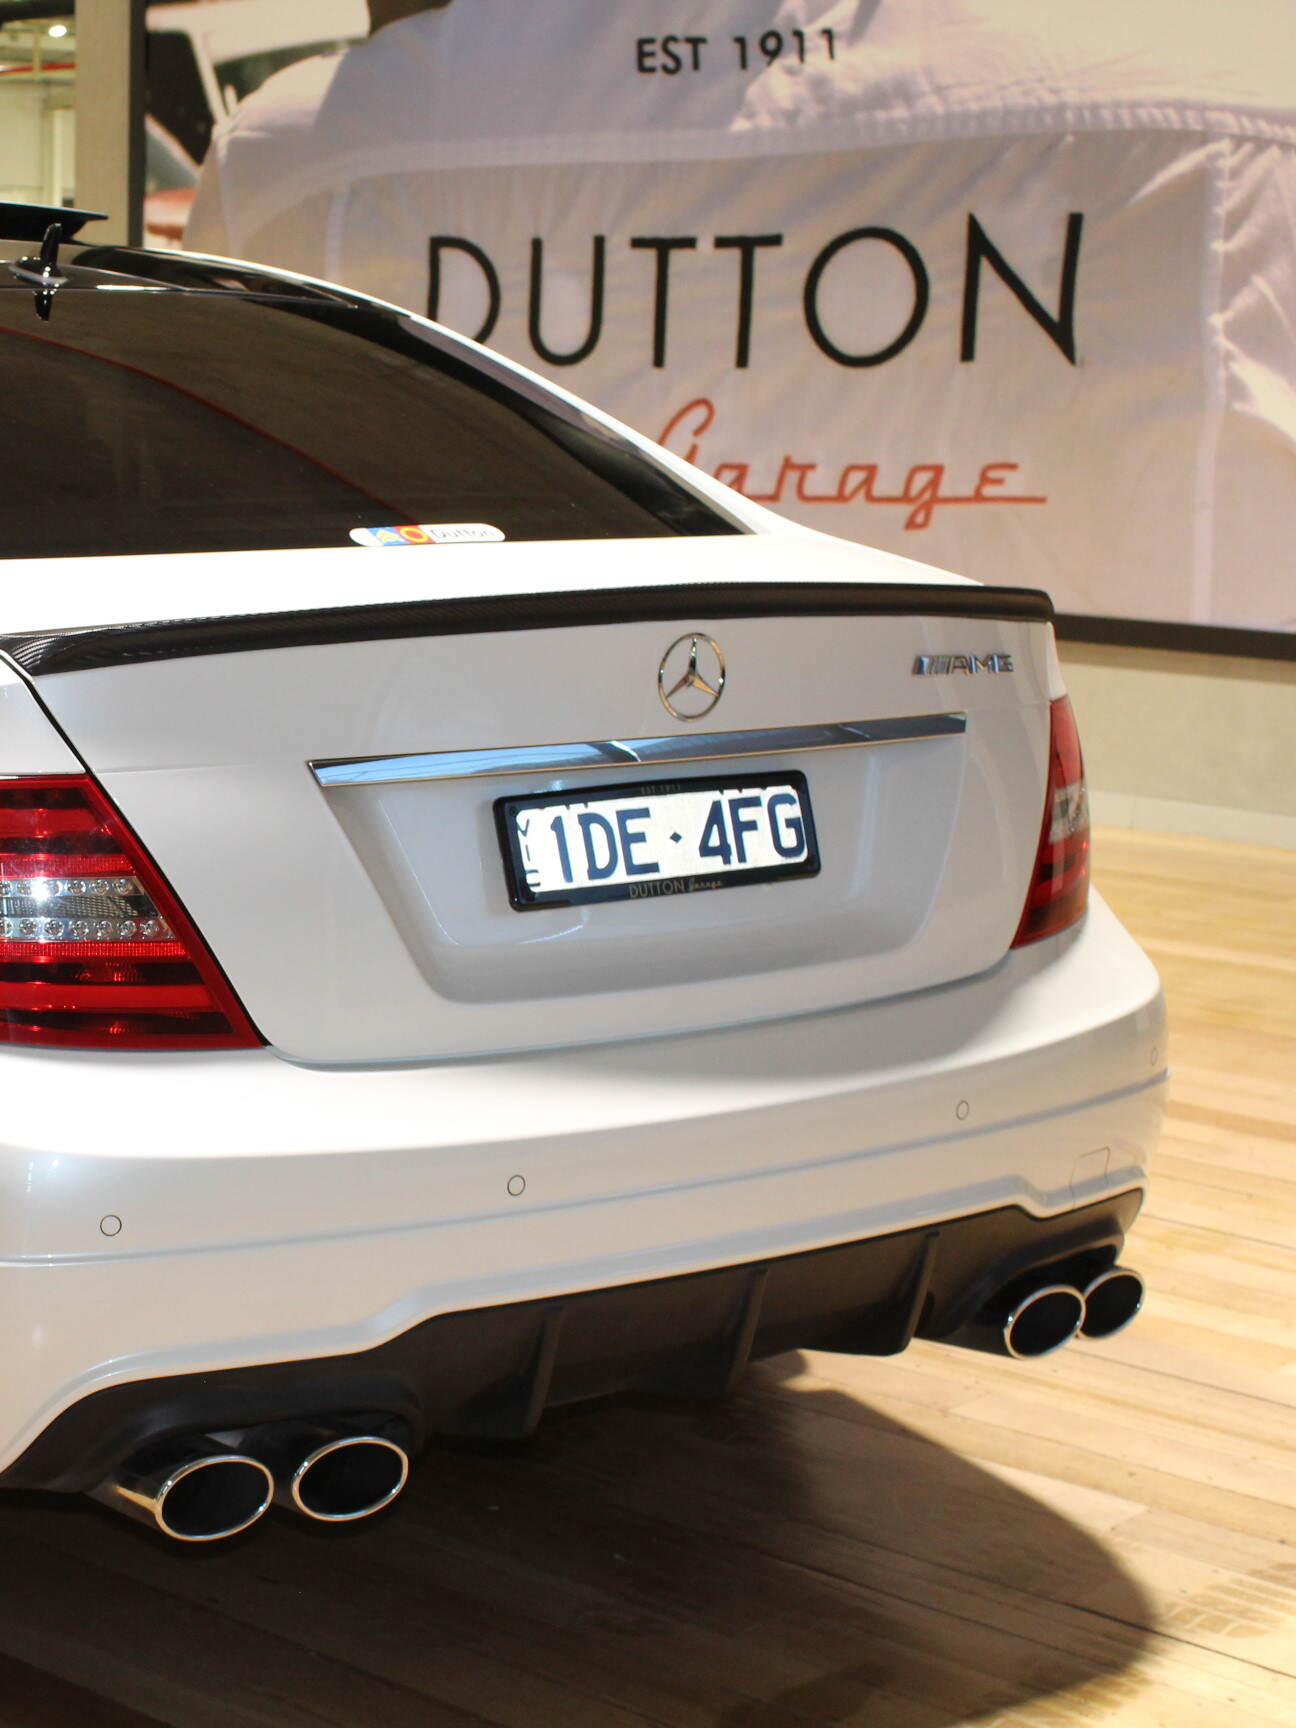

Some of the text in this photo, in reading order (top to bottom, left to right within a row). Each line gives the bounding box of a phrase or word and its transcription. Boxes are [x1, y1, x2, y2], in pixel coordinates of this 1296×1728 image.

[636, 29, 838, 75] EST 1911
[427, 212, 1084, 369] DUTTON
[658, 398, 1046, 531] Garage
[628, 879, 685, 899] DUTTON
